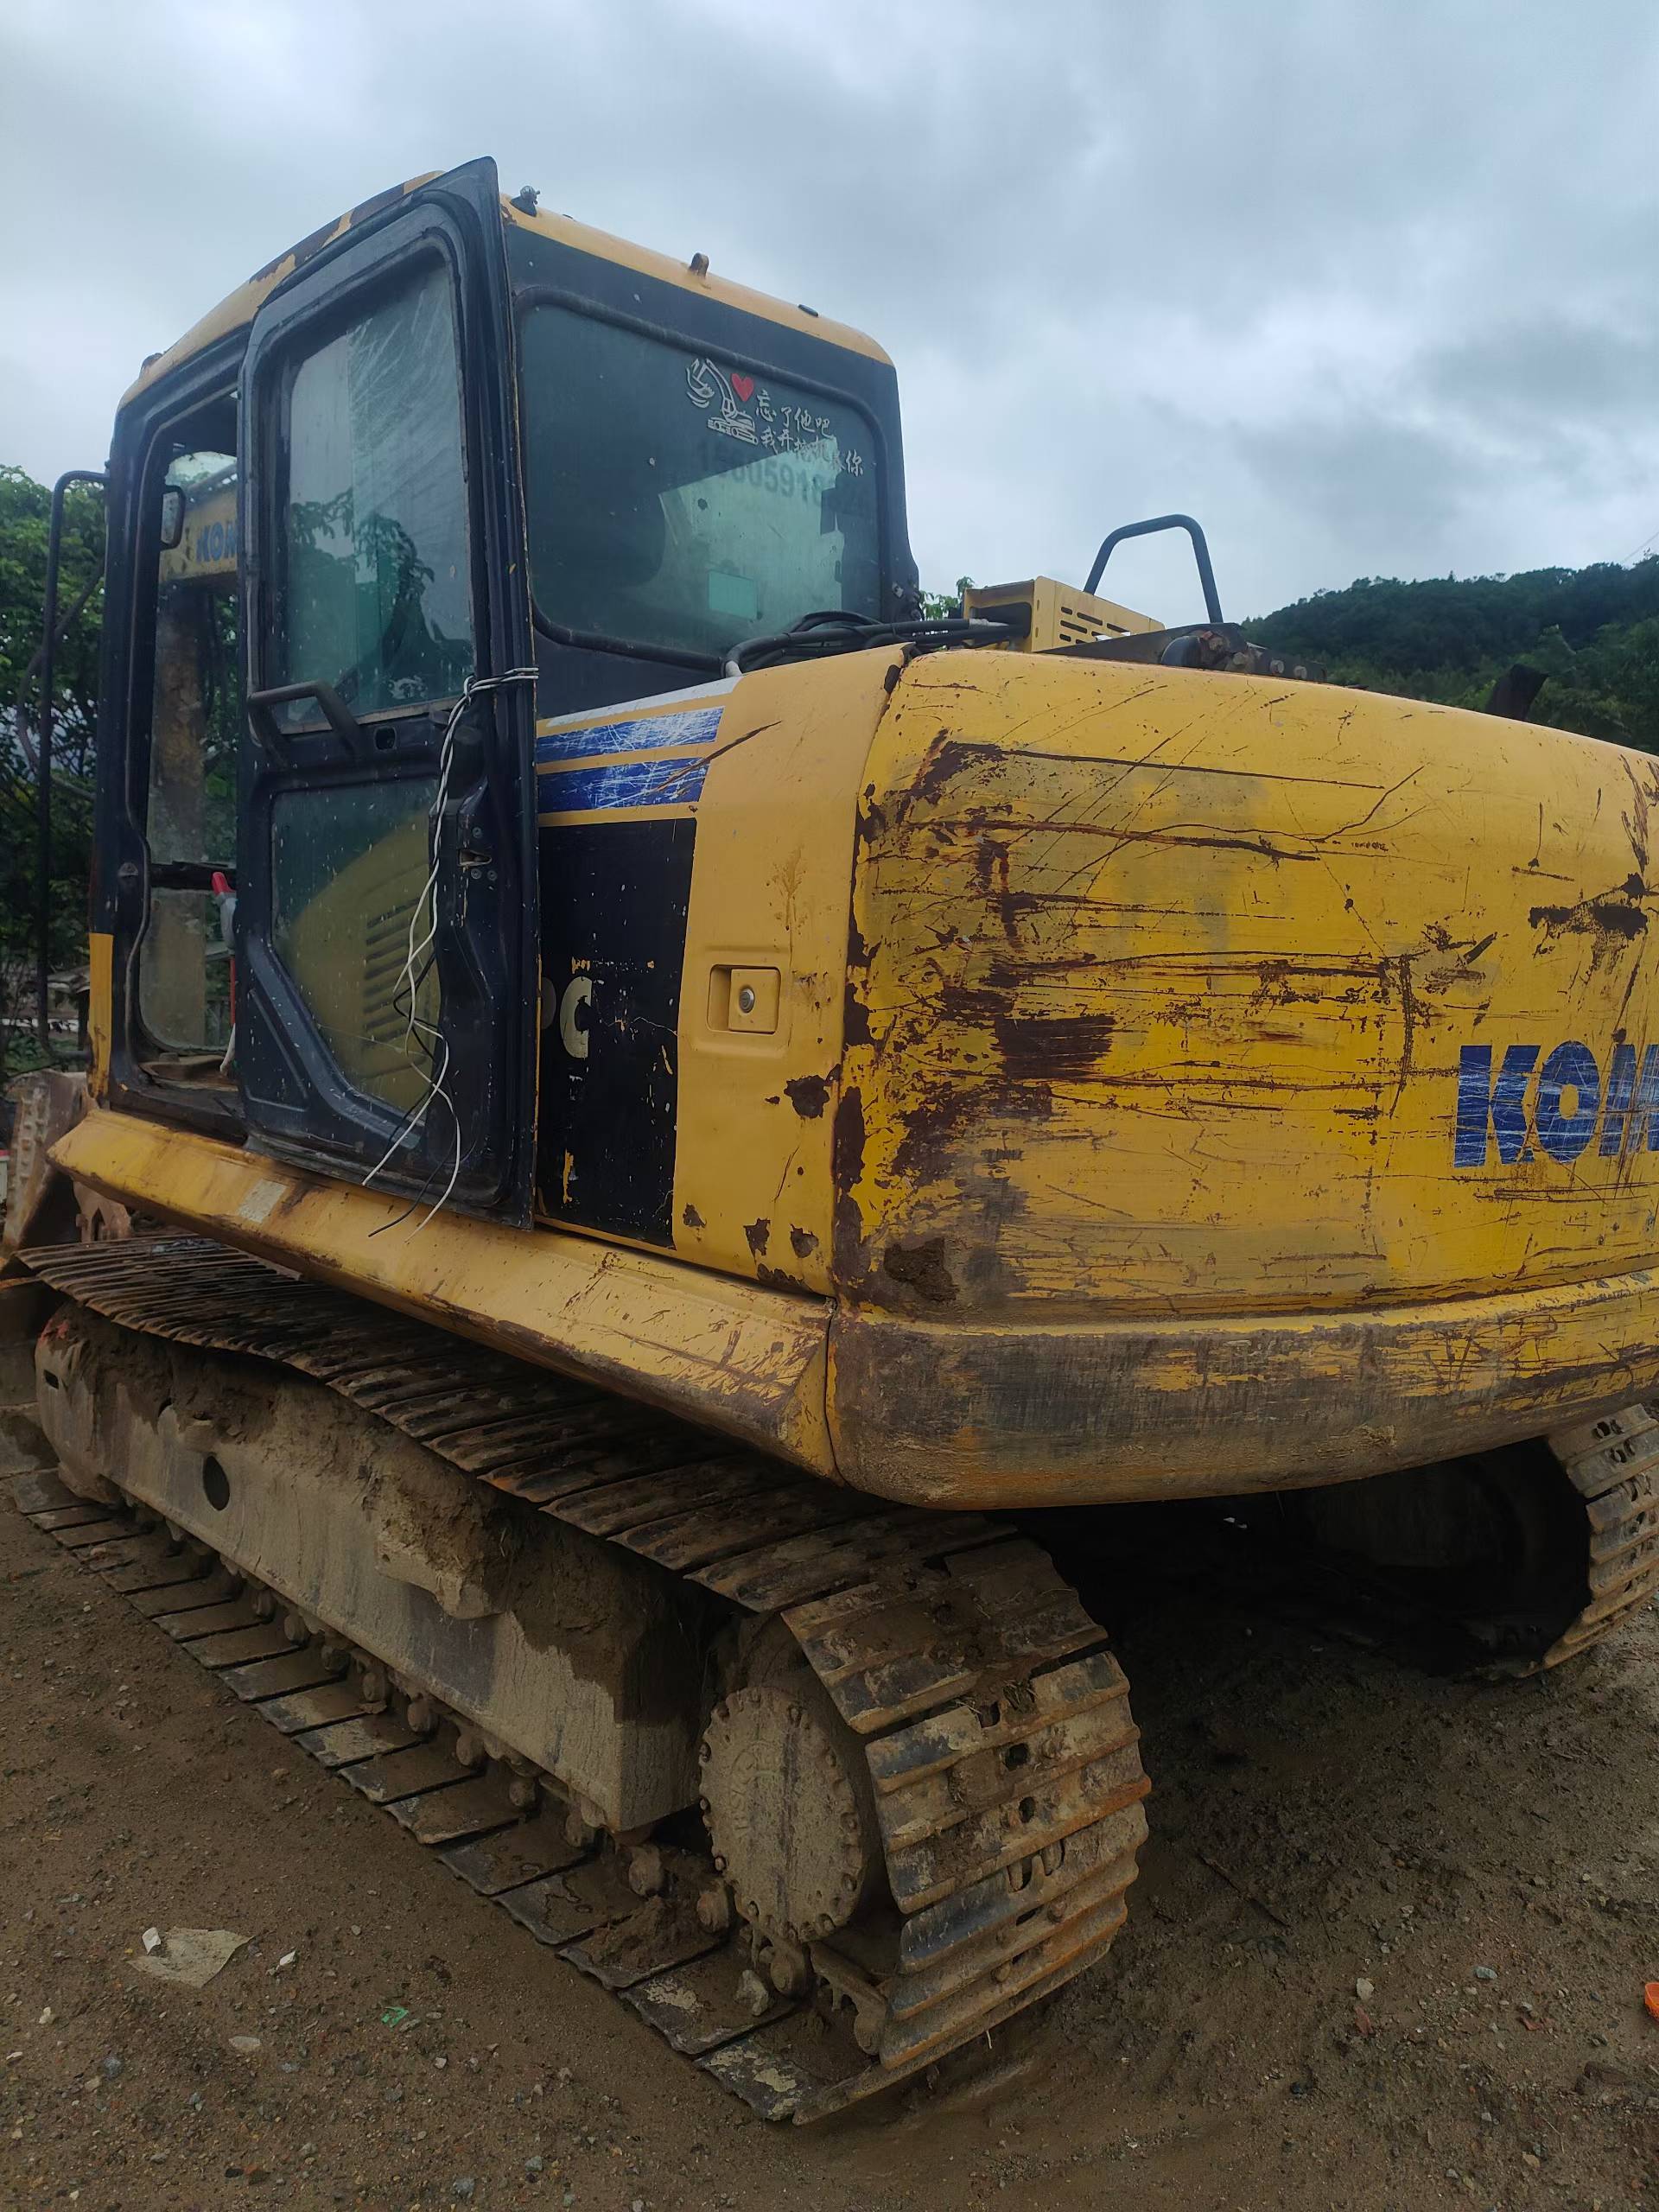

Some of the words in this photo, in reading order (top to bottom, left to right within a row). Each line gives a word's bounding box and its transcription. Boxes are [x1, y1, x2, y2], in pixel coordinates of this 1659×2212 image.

[755, 388, 836, 439] 忘了他吧
[539, 976, 593, 1059] C
